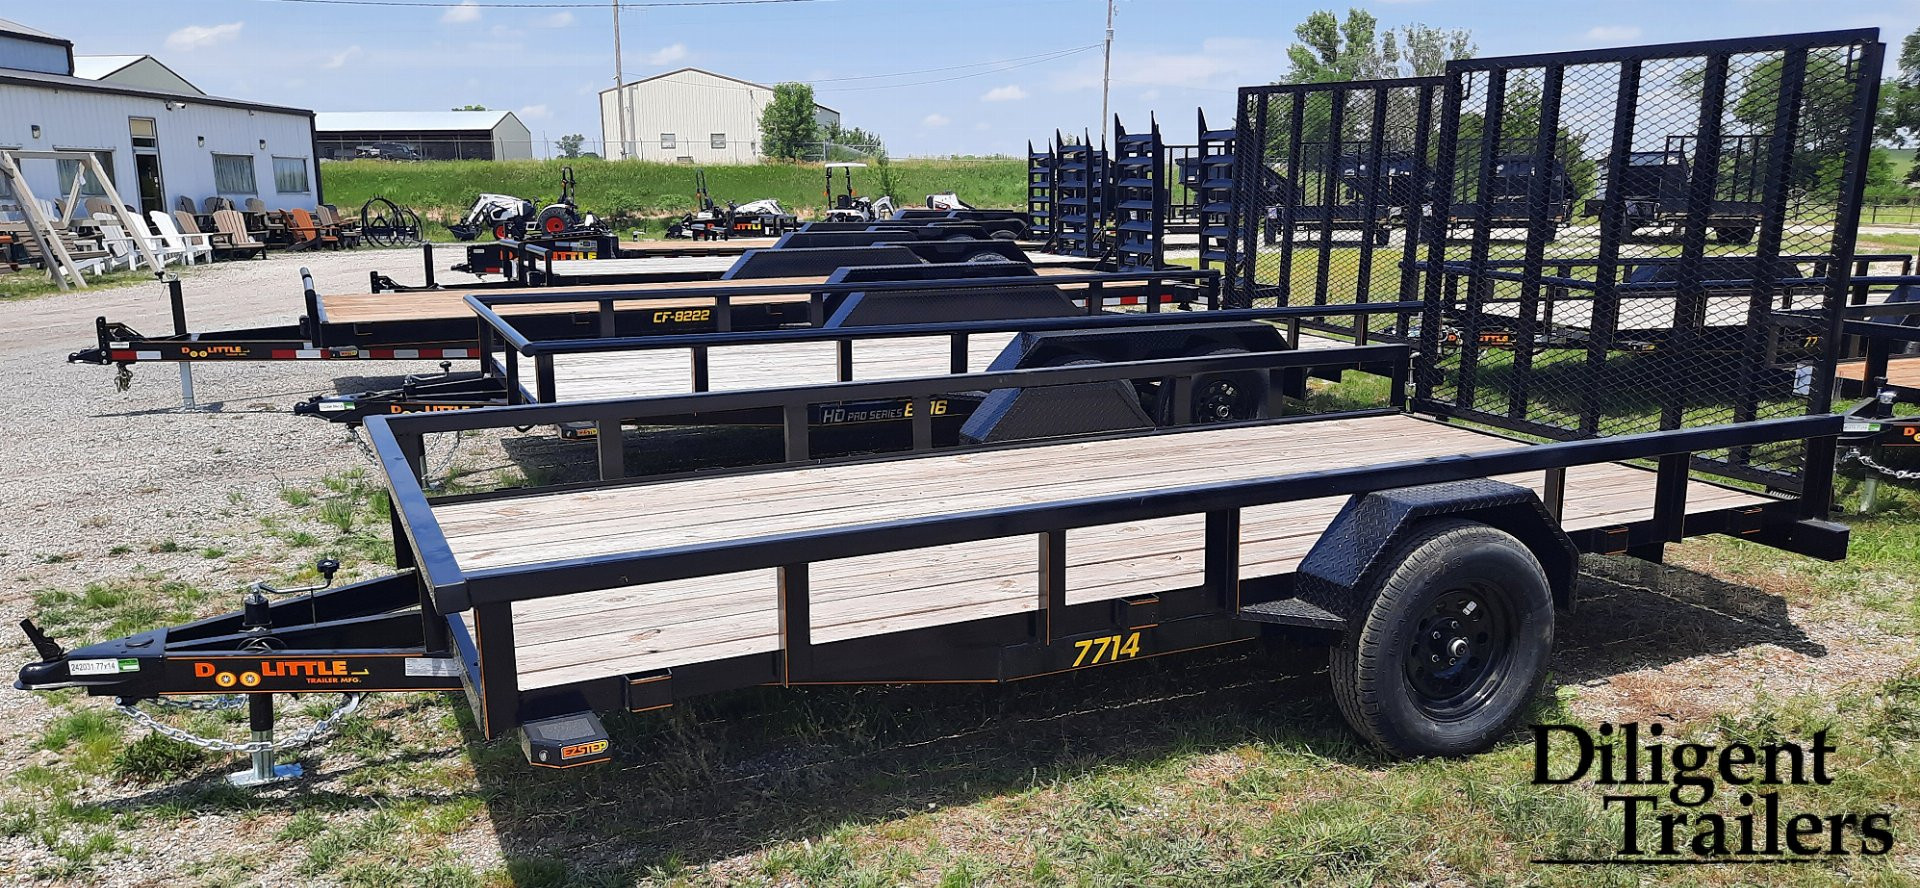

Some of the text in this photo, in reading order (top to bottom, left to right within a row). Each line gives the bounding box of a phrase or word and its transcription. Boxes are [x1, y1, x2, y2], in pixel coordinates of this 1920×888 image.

[653, 310, 710, 323] CF-8222
[181, 346, 241, 358] DOOLITTLE
[823, 408, 902, 423] HD PRO SERIES
[904, 400, 948, 416] 816
[1072, 632, 1141, 668] 7714
[194, 660, 348, 688] DOOLITTLE
[562, 741, 607, 758] EZSTEP
